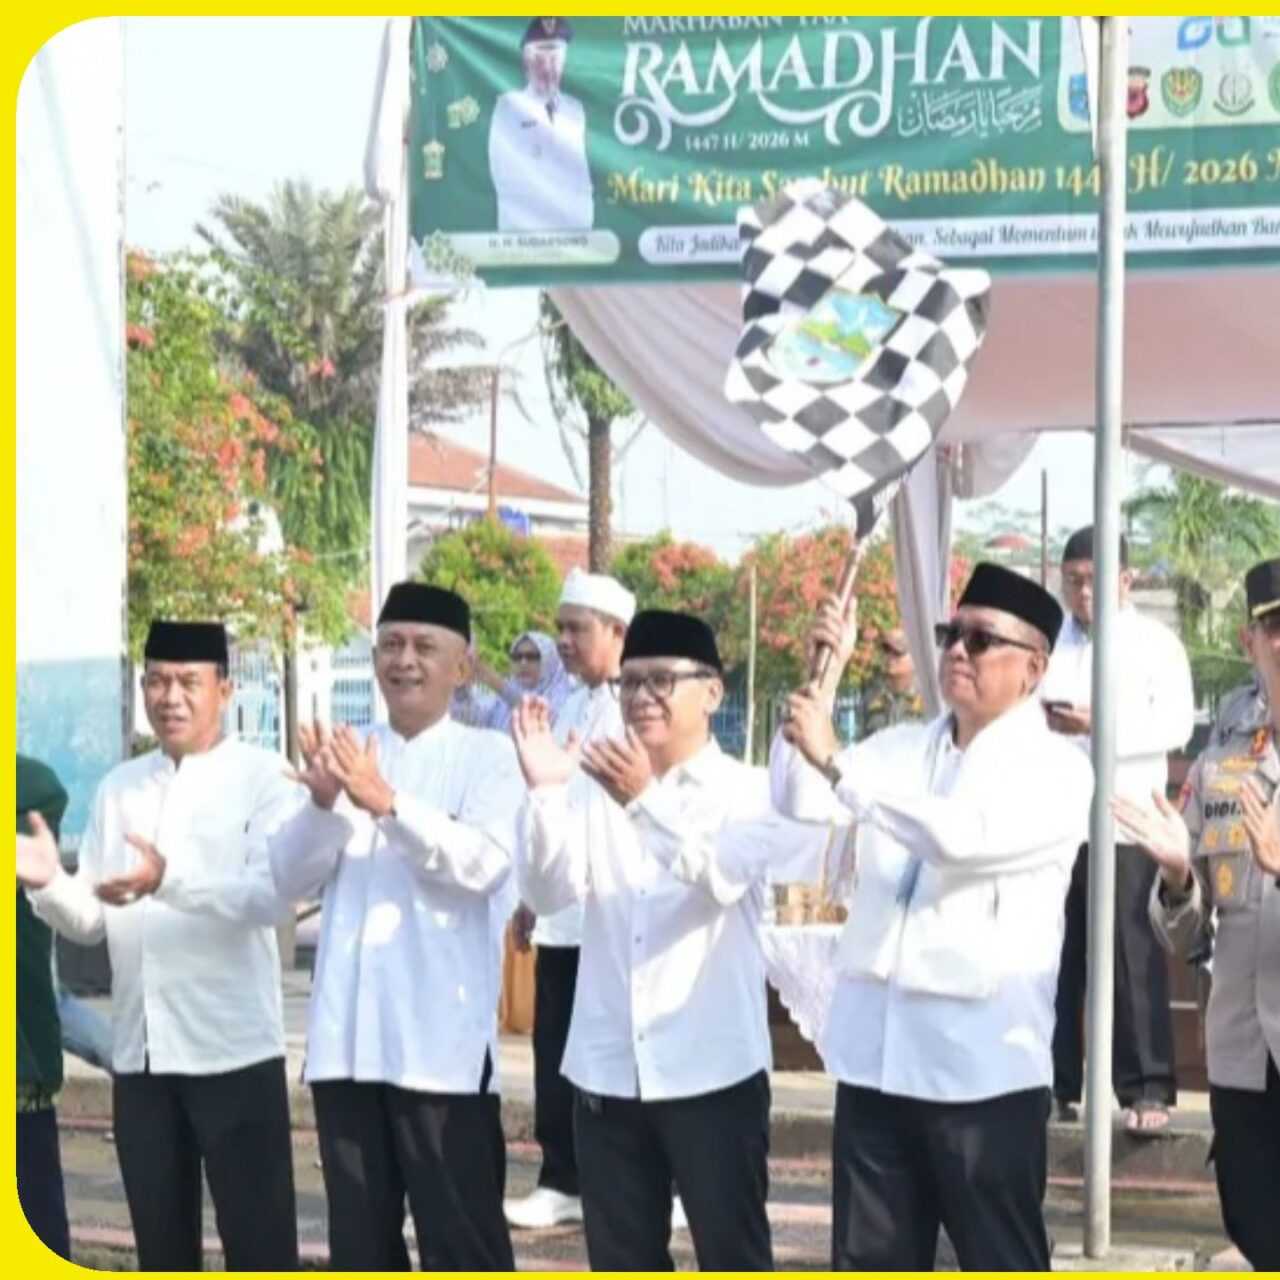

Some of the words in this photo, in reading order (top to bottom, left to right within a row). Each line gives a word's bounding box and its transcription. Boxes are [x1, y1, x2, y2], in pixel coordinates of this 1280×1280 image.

[614, 16, 1042, 150] RAMADHAN
[749, 131, 789, 149] 2026
[793, 129, 809, 147] M
[608, 167, 680, 204] Mari
[689, 167, 751, 206] Kita
[879, 156, 1047, 201] Ramadhan
[1055, 163, 1104, 197] 144
[1183, 152, 1258, 187] 2026
[932, 225, 995, 250] Sebagai
[998, 220, 1088, 246] Momentum
